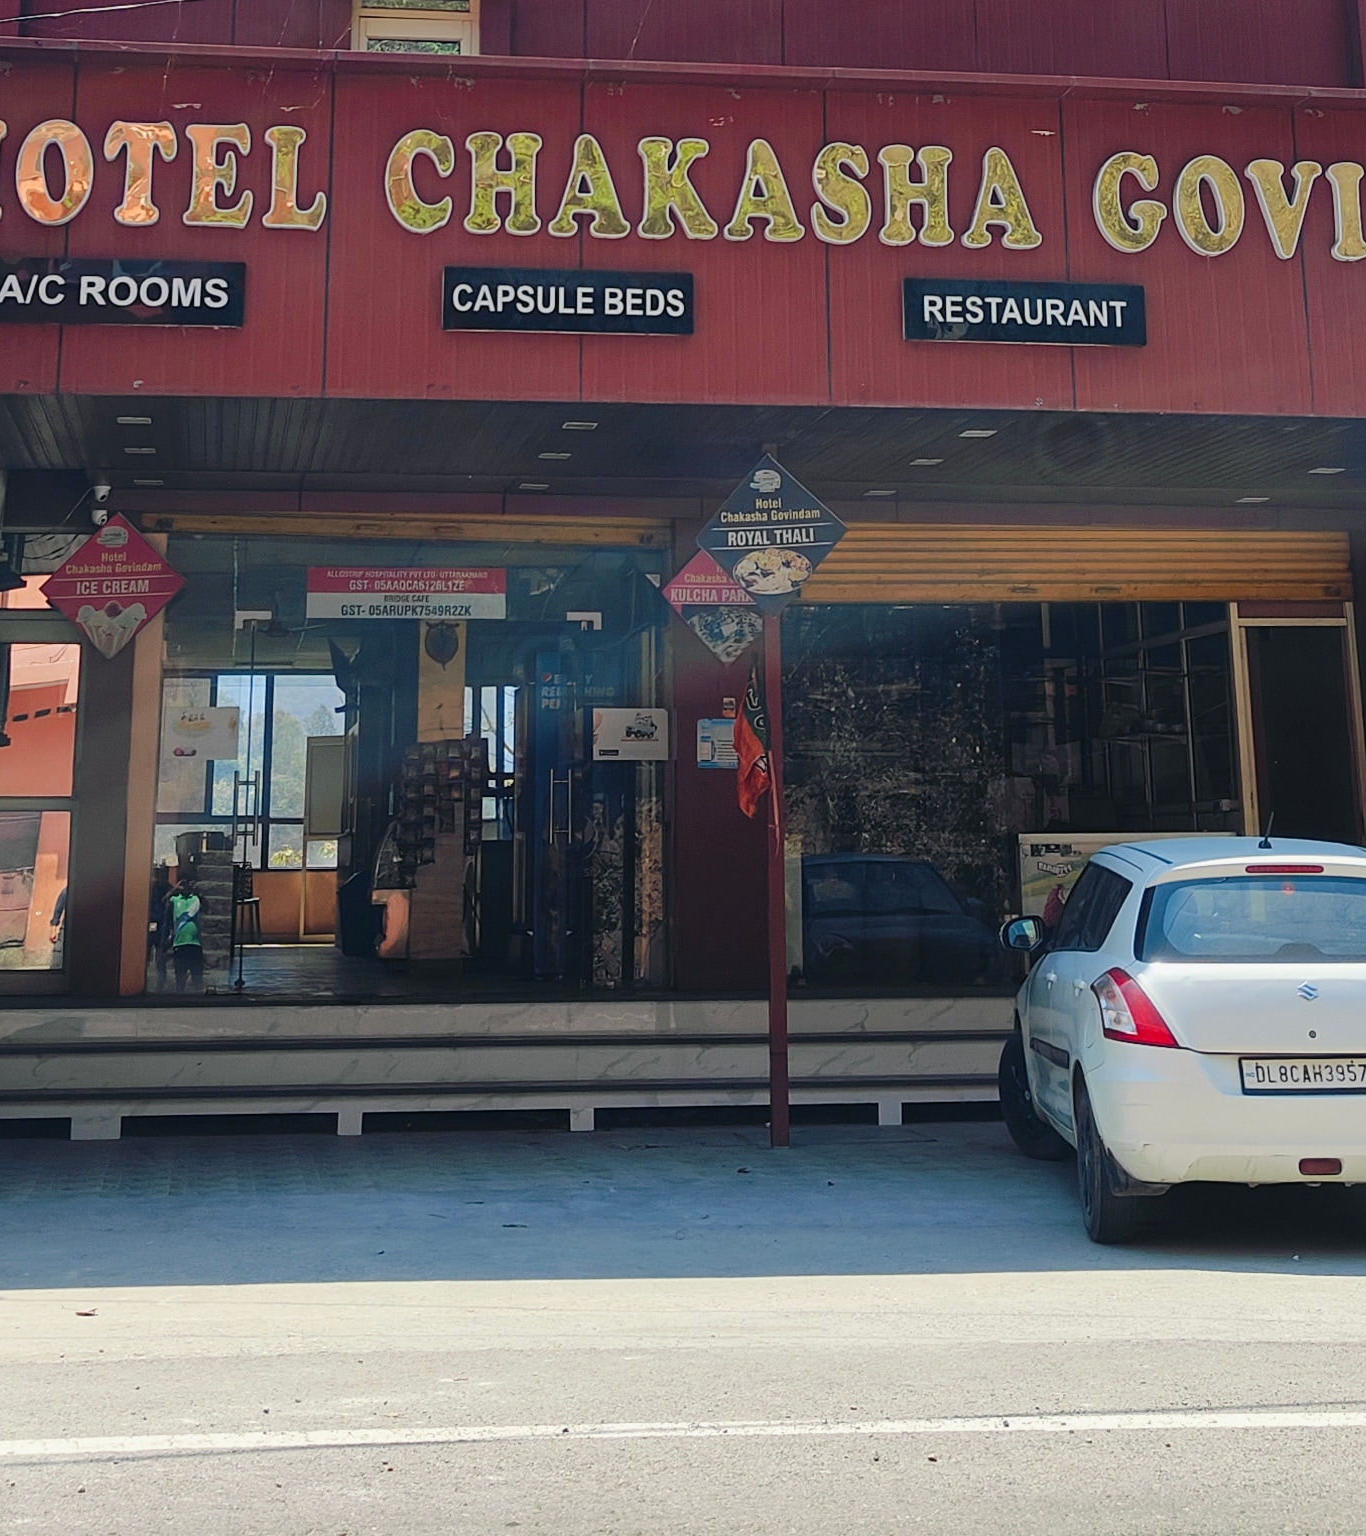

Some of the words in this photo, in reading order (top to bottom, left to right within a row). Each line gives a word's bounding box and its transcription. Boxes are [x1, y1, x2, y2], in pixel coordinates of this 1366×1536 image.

[383, 128, 1043, 251] CHAKASHA
[78, 275, 230, 310] ROOMS
[451, 282, 595, 316] CAPSULE
[603, 286, 686, 319] BEDS
[922, 294, 1128, 331] RESTAURANT
[756, 497, 781, 510] Hotel
[720, 511, 768, 524] Chakasha
[771, 508, 820, 521] Govindam
[727, 530, 771, 546] ROYAL
[774, 527, 815, 545] THALI
[101, 552, 126, 563] Hotel
[65, 563, 112, 575] Chakasha
[115, 562, 161, 574] Govindam
[76, 581, 98, 595] ICE
[102, 579, 150, 594] CREAM
[670, 588, 718, 602] KULCHA
[341, 605, 366, 616] GST-
